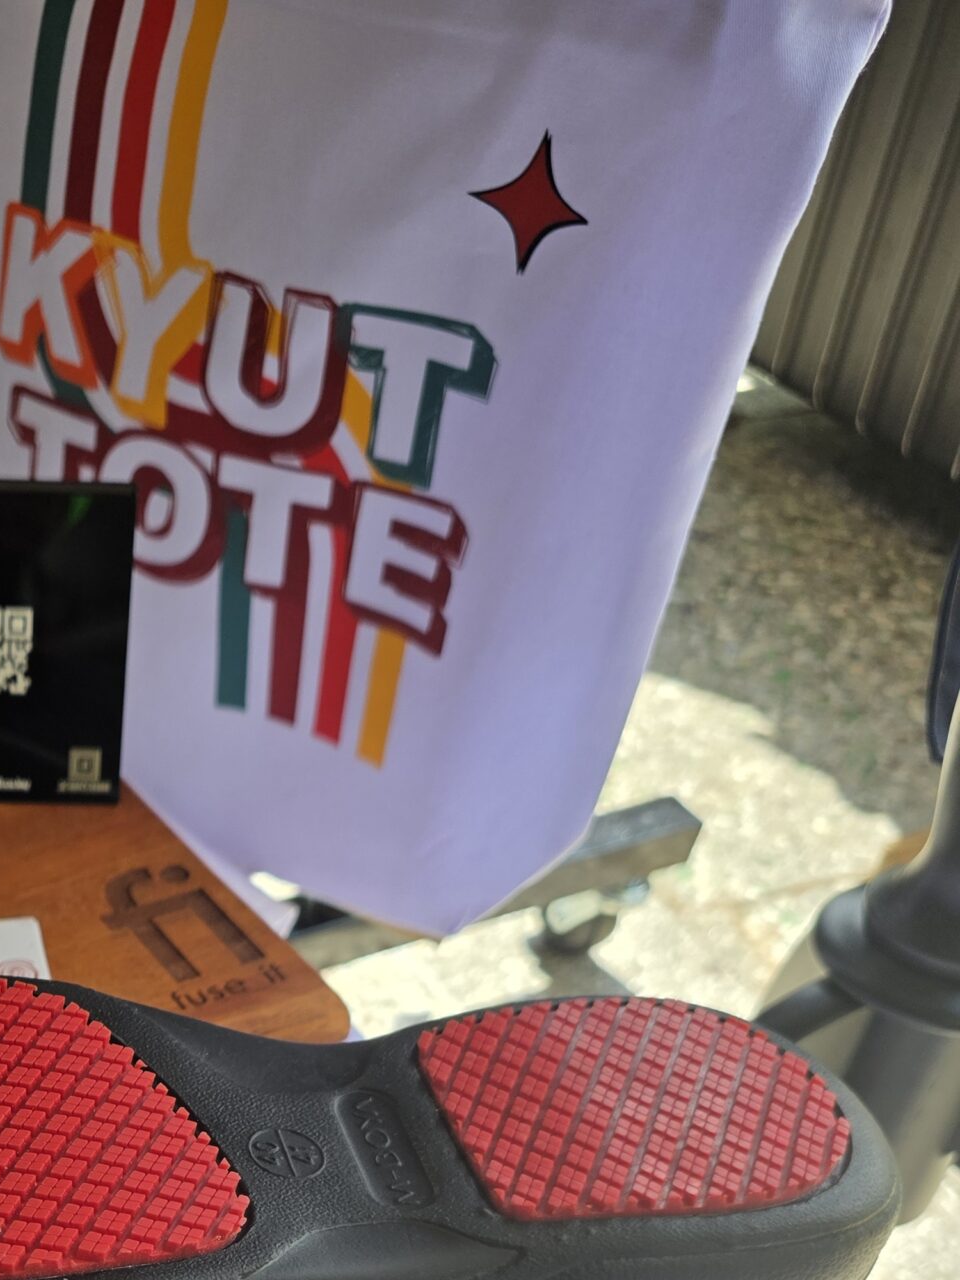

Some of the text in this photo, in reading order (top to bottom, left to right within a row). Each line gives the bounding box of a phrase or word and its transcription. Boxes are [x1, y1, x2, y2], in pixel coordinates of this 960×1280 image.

[9, 384, 468, 658] TOTE
[171, 961, 288, 1010] fuse it
